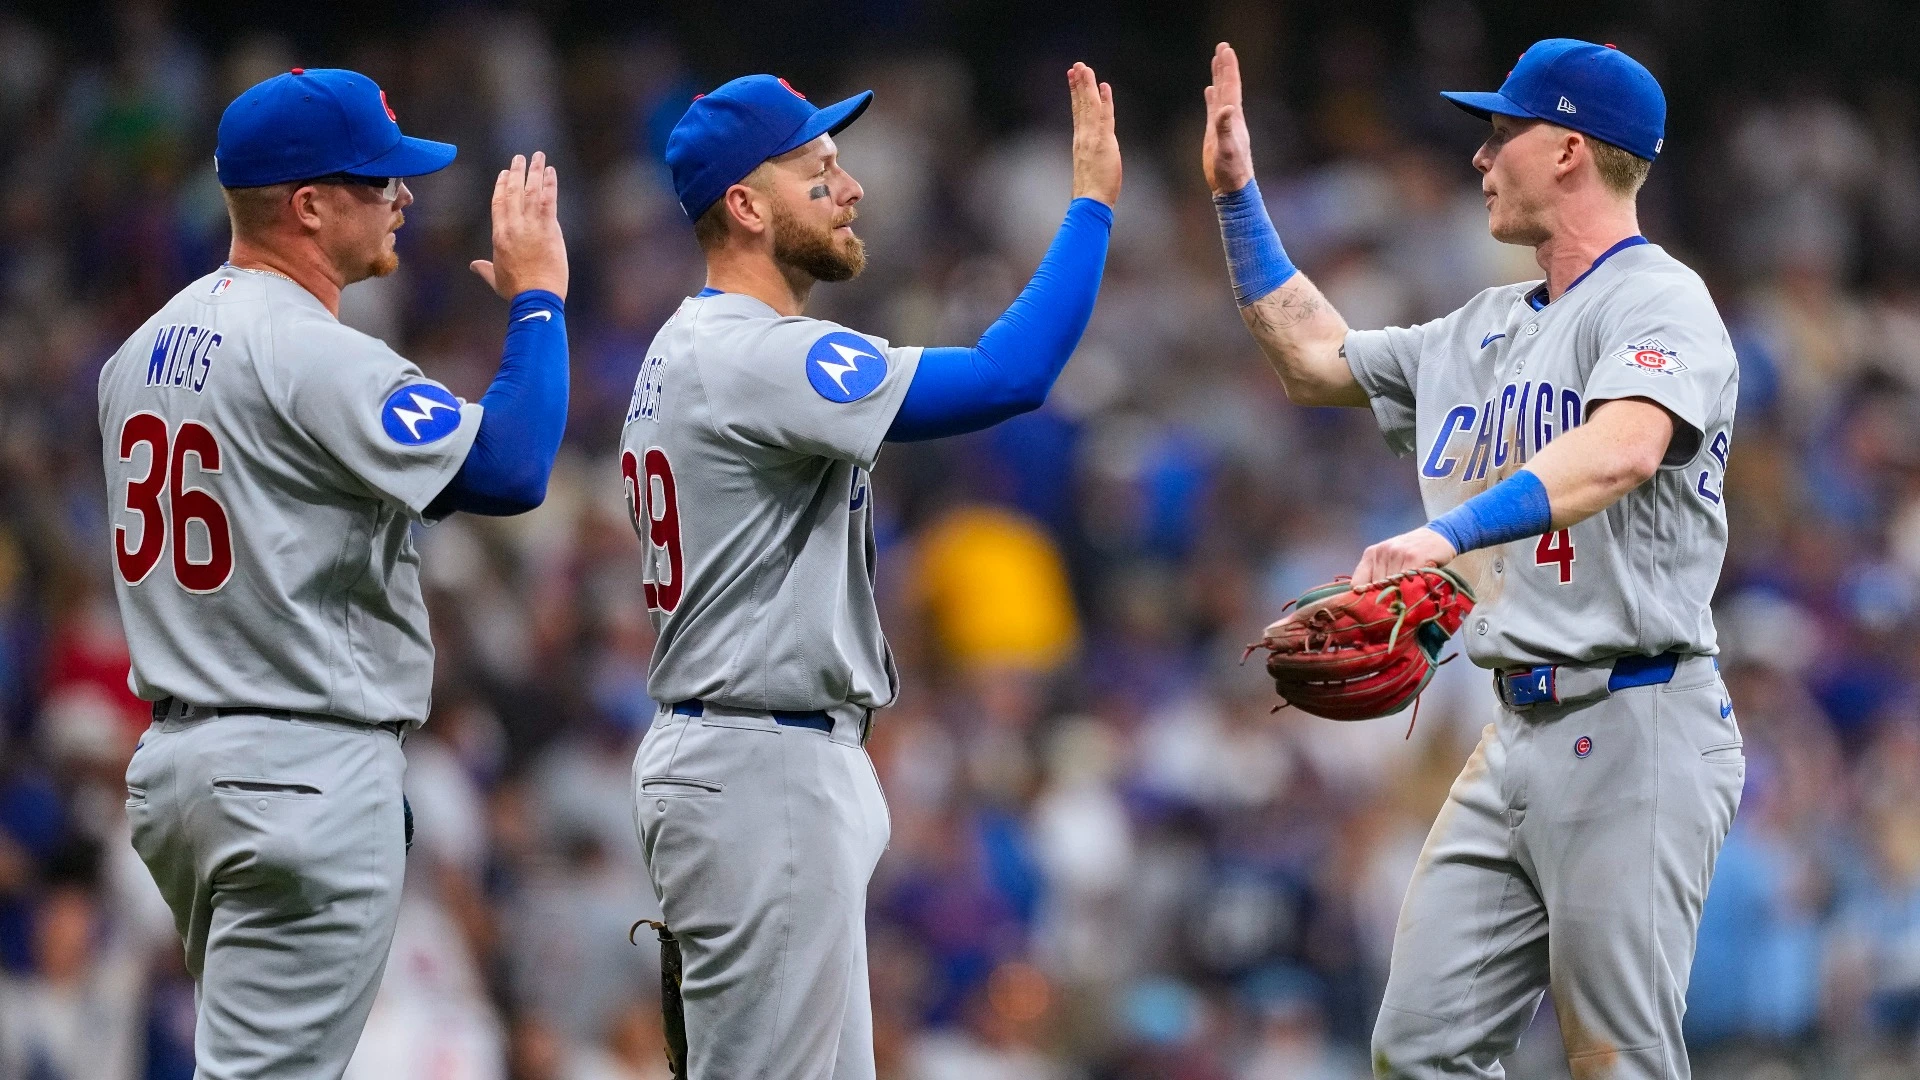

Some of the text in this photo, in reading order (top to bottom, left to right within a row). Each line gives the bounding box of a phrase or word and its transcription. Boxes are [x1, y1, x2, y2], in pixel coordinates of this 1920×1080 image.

[146, 324, 223, 395] WICKS
[1420, 379, 1584, 484] CHCAGO
[115, 411, 235, 595] 36
[621, 446, 685, 616] 29
[1535, 527, 1576, 585] 4
[1538, 675, 1547, 694] 4
